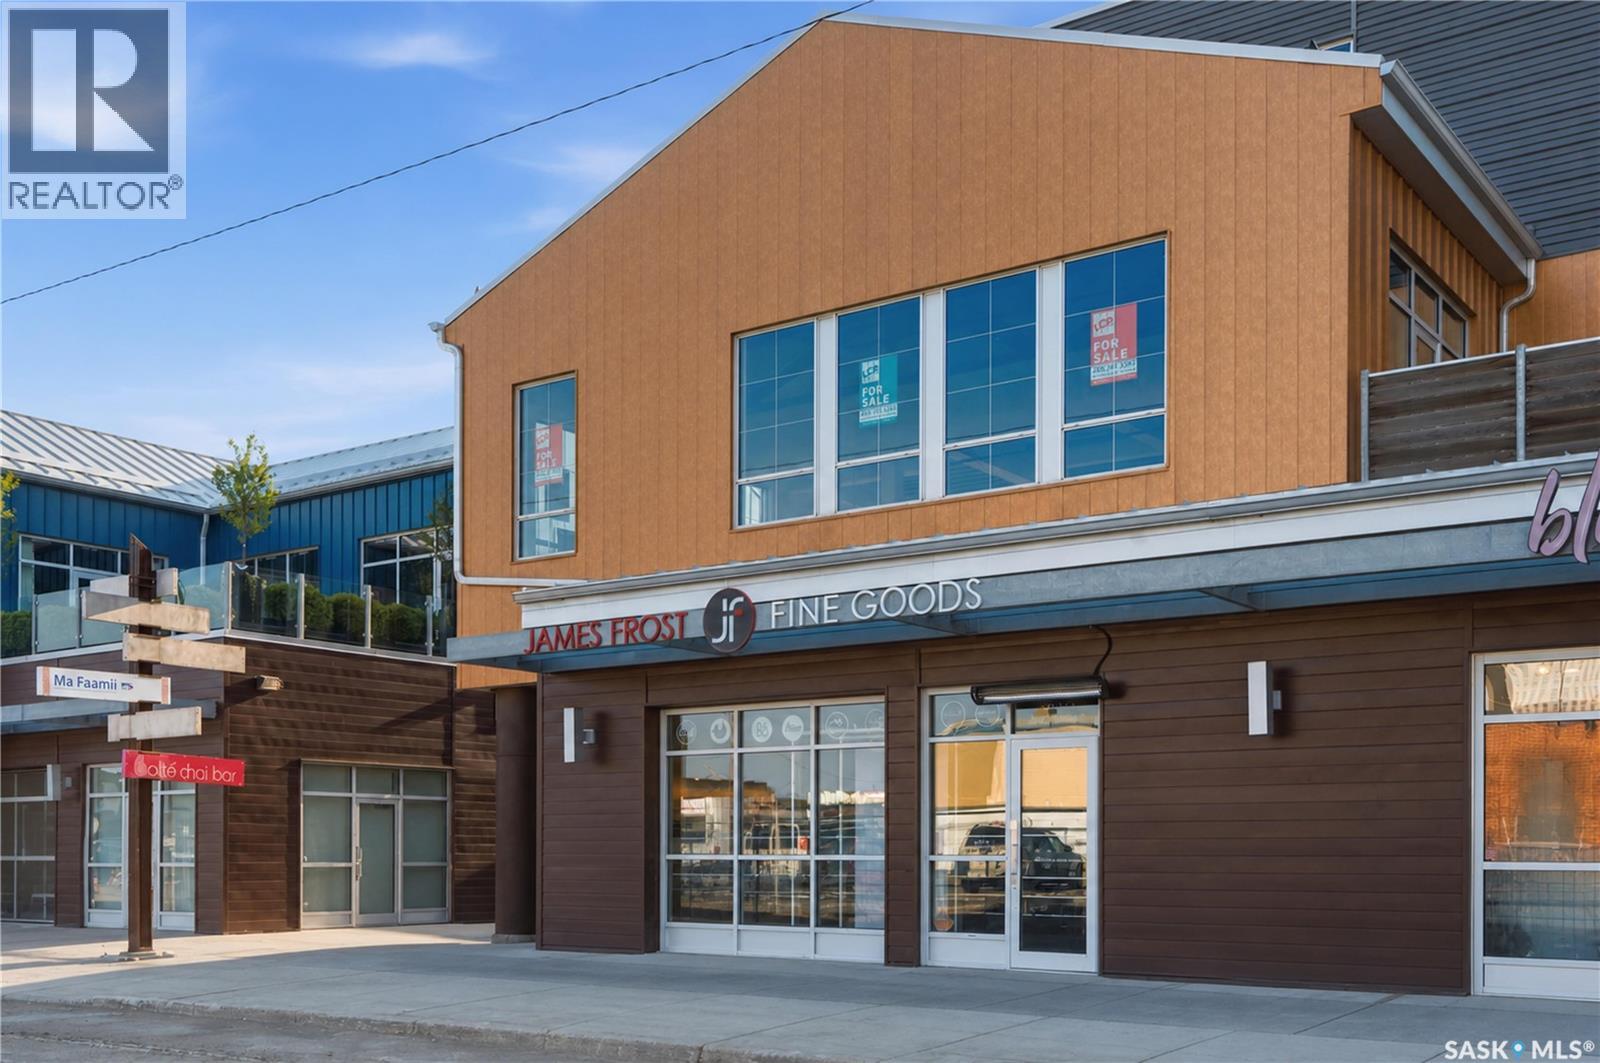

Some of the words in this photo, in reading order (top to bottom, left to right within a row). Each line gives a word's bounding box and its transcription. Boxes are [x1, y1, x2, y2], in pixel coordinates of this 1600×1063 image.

[1093, 338, 1119, 353] FOR
[1093, 348, 1128, 364] SALE
[862, 385, 883, 398] FOR
[862, 394, 890, 408] SALE
[1528, 448, 1600, 565] bl
[771, 594, 840, 629] FINE
[851, 578, 983, 620] GOODS
[523, 620, 603, 655] JAMES
[610, 610, 689, 646] FROST
[54, 674, 73, 688] Ma
[77, 676, 117, 690] Faamii
[212, 765, 237, 783] bar
